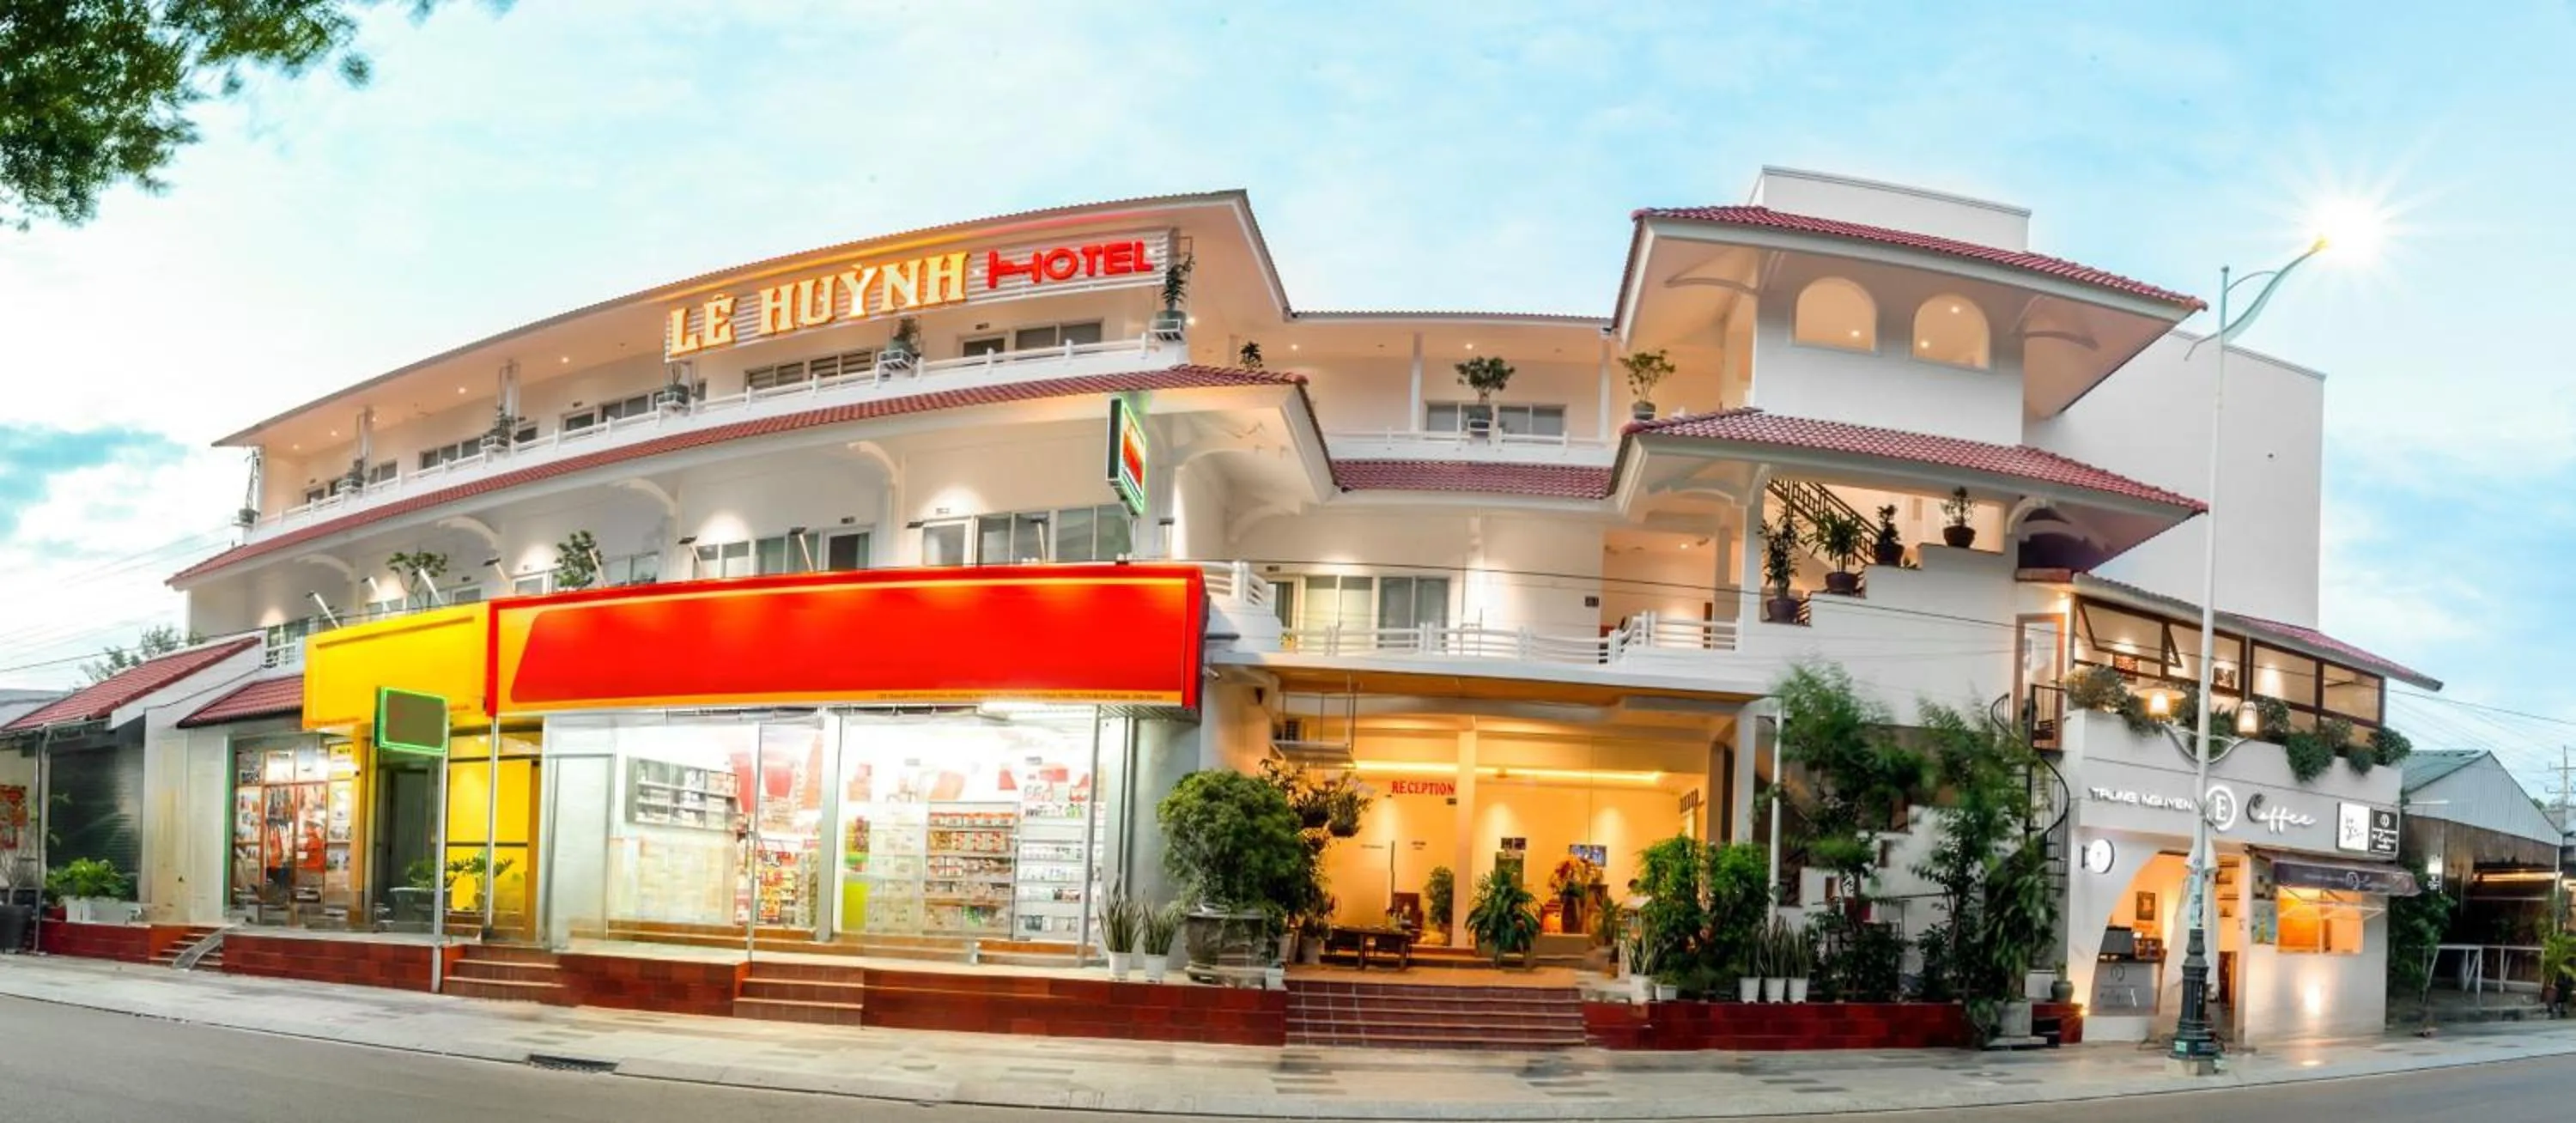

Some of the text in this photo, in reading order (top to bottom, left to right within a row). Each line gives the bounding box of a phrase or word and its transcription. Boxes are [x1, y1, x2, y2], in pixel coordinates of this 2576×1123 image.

[988, 241, 1154, 288] HOTEL
[670, 250, 970, 357] LÊ HUỲNH
[1391, 780, 1455, 796] RECEPTION
[2246, 793, 2317, 835] Coffee
